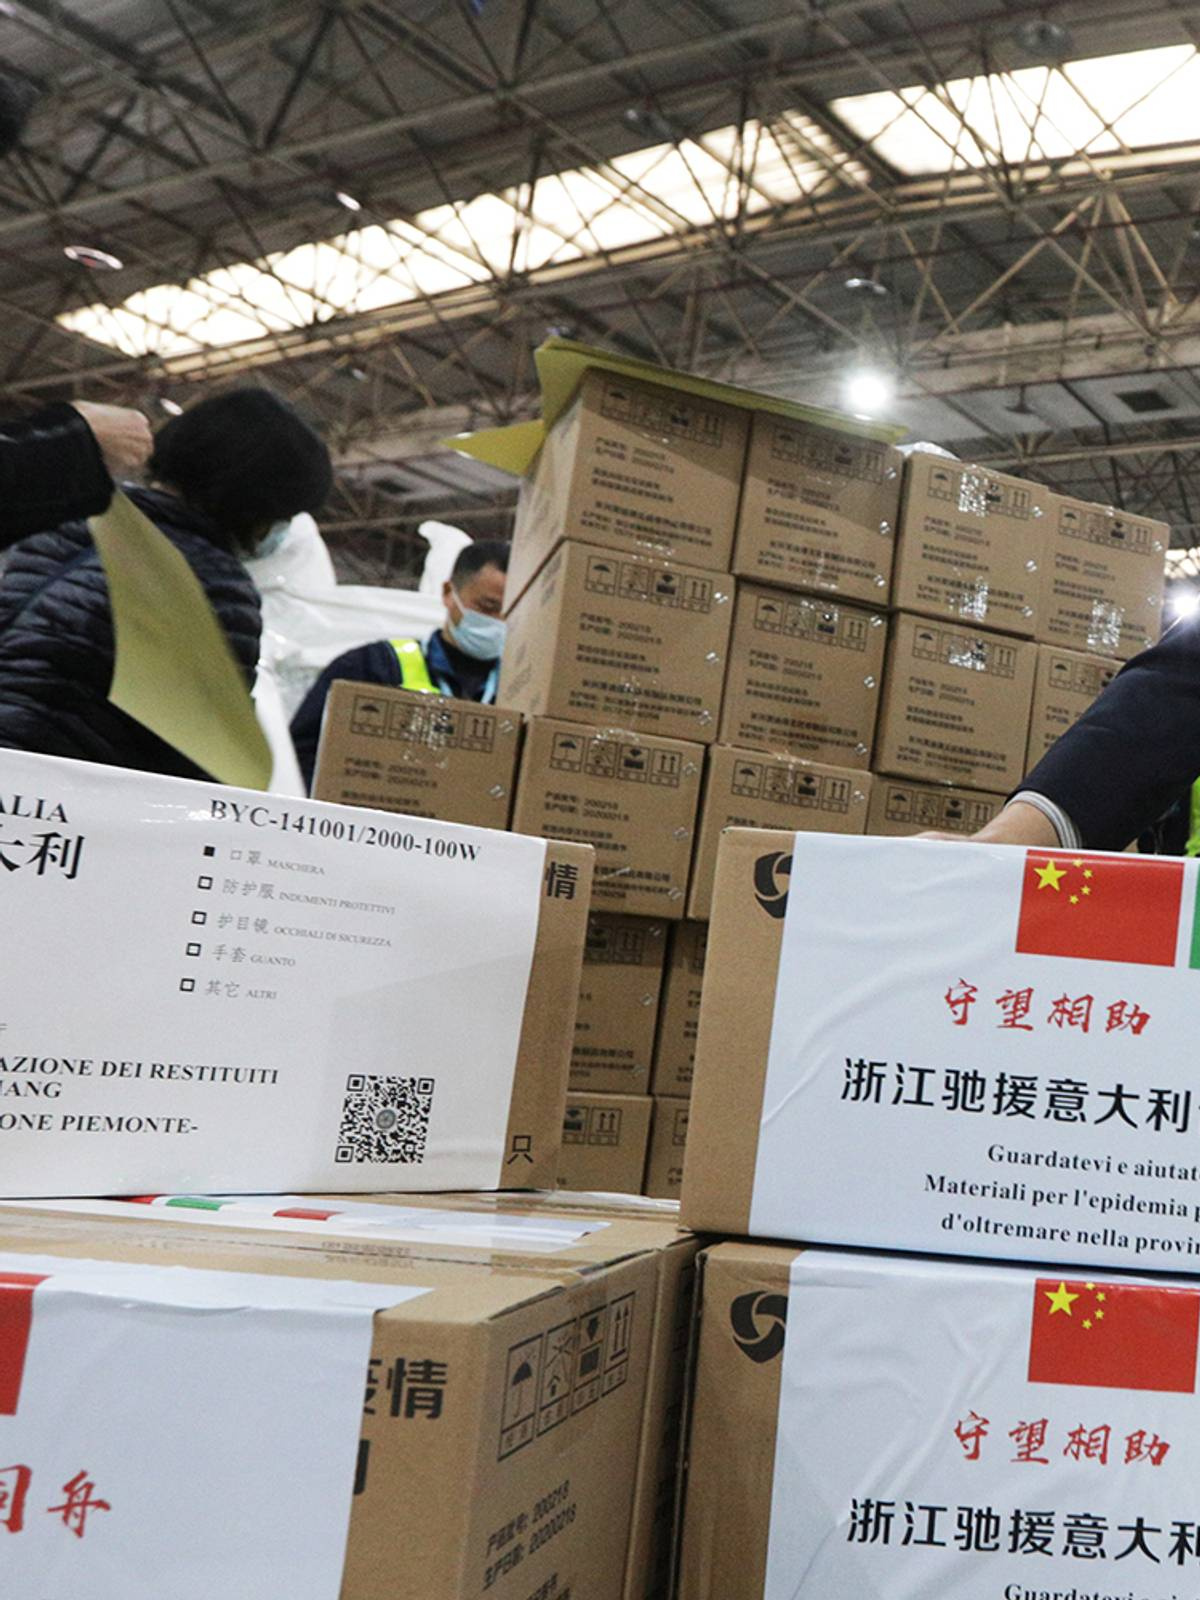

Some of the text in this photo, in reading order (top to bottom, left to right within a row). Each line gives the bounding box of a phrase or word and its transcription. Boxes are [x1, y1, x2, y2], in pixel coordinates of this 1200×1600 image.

[210, 799, 481, 861] BYC-141001/2000-100W
[268, 859, 325, 875] MASCHERA
[544, 861, 578, 899] 情
[222, 878, 395, 915] 防护服 INDUMENTI PROTETTIVI
[218, 912, 392, 947] 护目镜 OCCHIALI DI SICUREZZA
[212, 944, 295, 967] 手套 GUANTO
[205, 979, 277, 999] 其它 ALTRI
[944, 978, 1151, 1035] 守望相助
[100, 1060, 142, 1078] DEI
[150, 1063, 279, 1084] RESTITUITI
[507, 1135, 533, 1165] 只
[988, 1144, 1111, 1173] Guardatevi
[1117, 1161, 1128, 1175] e
[924, 1174, 1025, 1201] Materiali
[1031, 1189, 1069, 1207] per
[1073, 1189, 1188, 1217] l'epidemia
[941, 1213, 1071, 1243] d'oltremare
[1076, 1229, 1129, 1249] nella
[954, 1410, 1171, 1467] 守望相助
